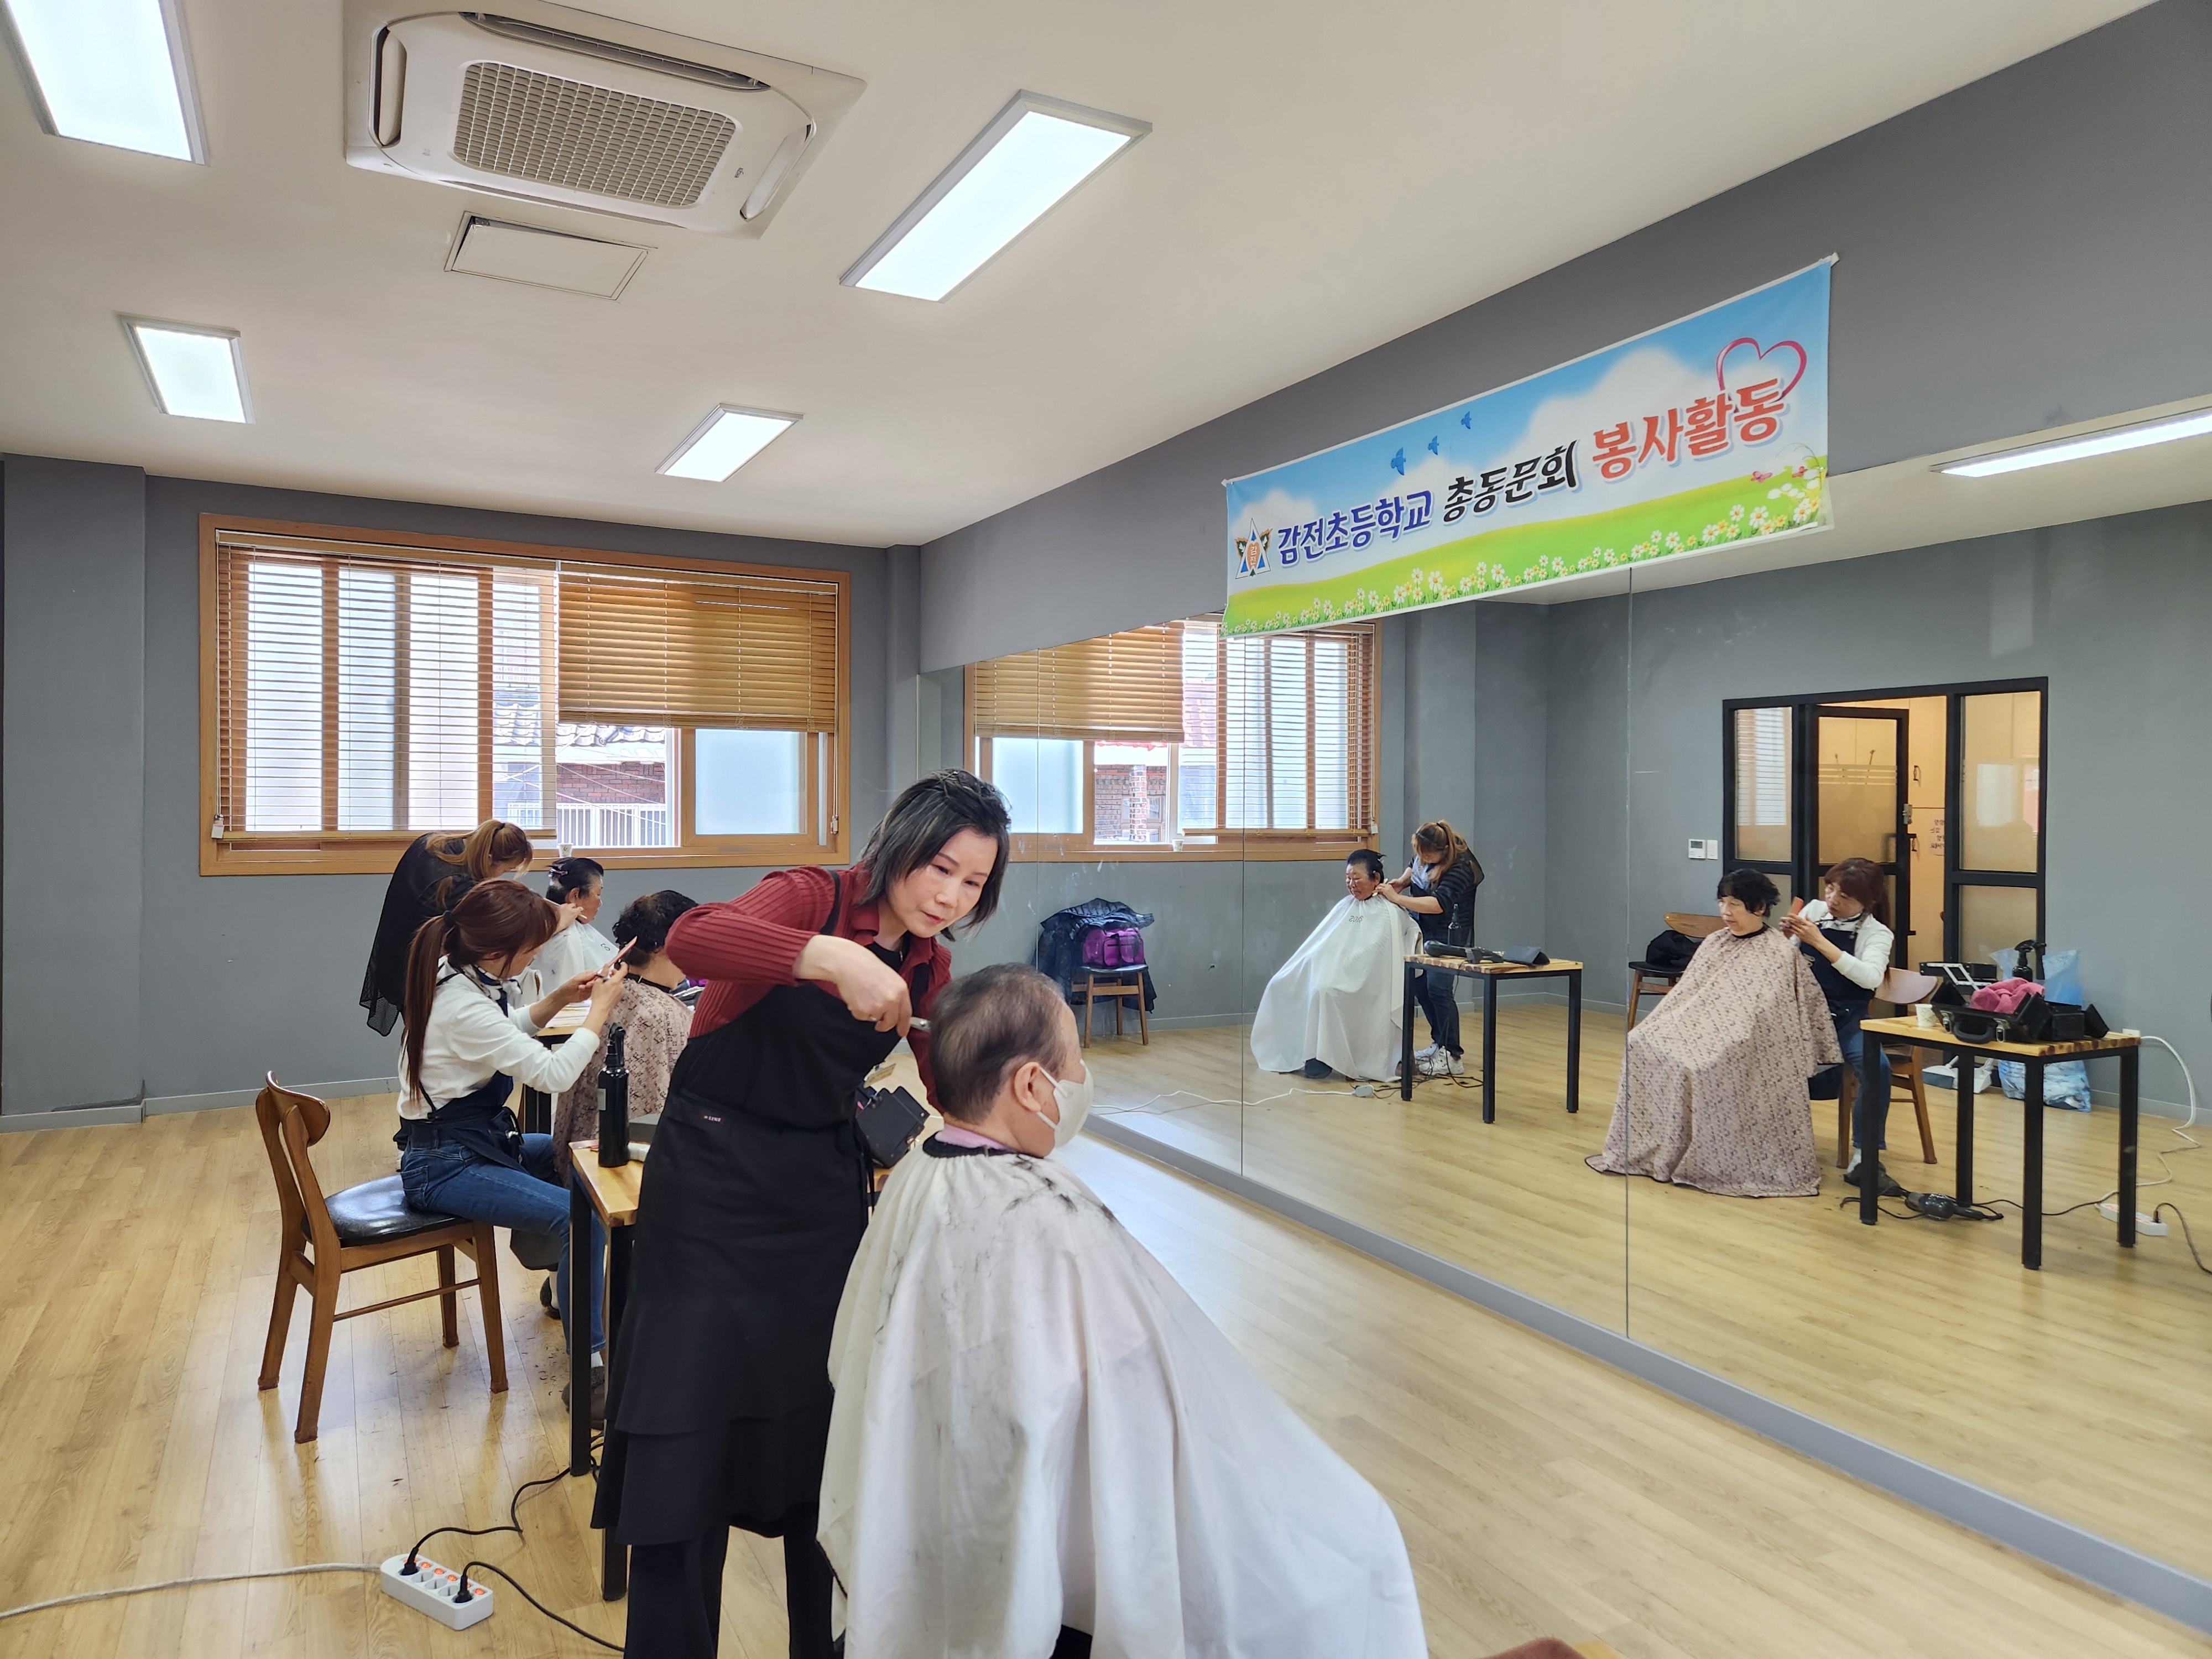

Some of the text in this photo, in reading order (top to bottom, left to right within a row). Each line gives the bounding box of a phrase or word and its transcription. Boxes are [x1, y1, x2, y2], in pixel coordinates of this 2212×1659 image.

[1277, 378, 1785, 565] 감전초등학교 총동문회 봉사활동
